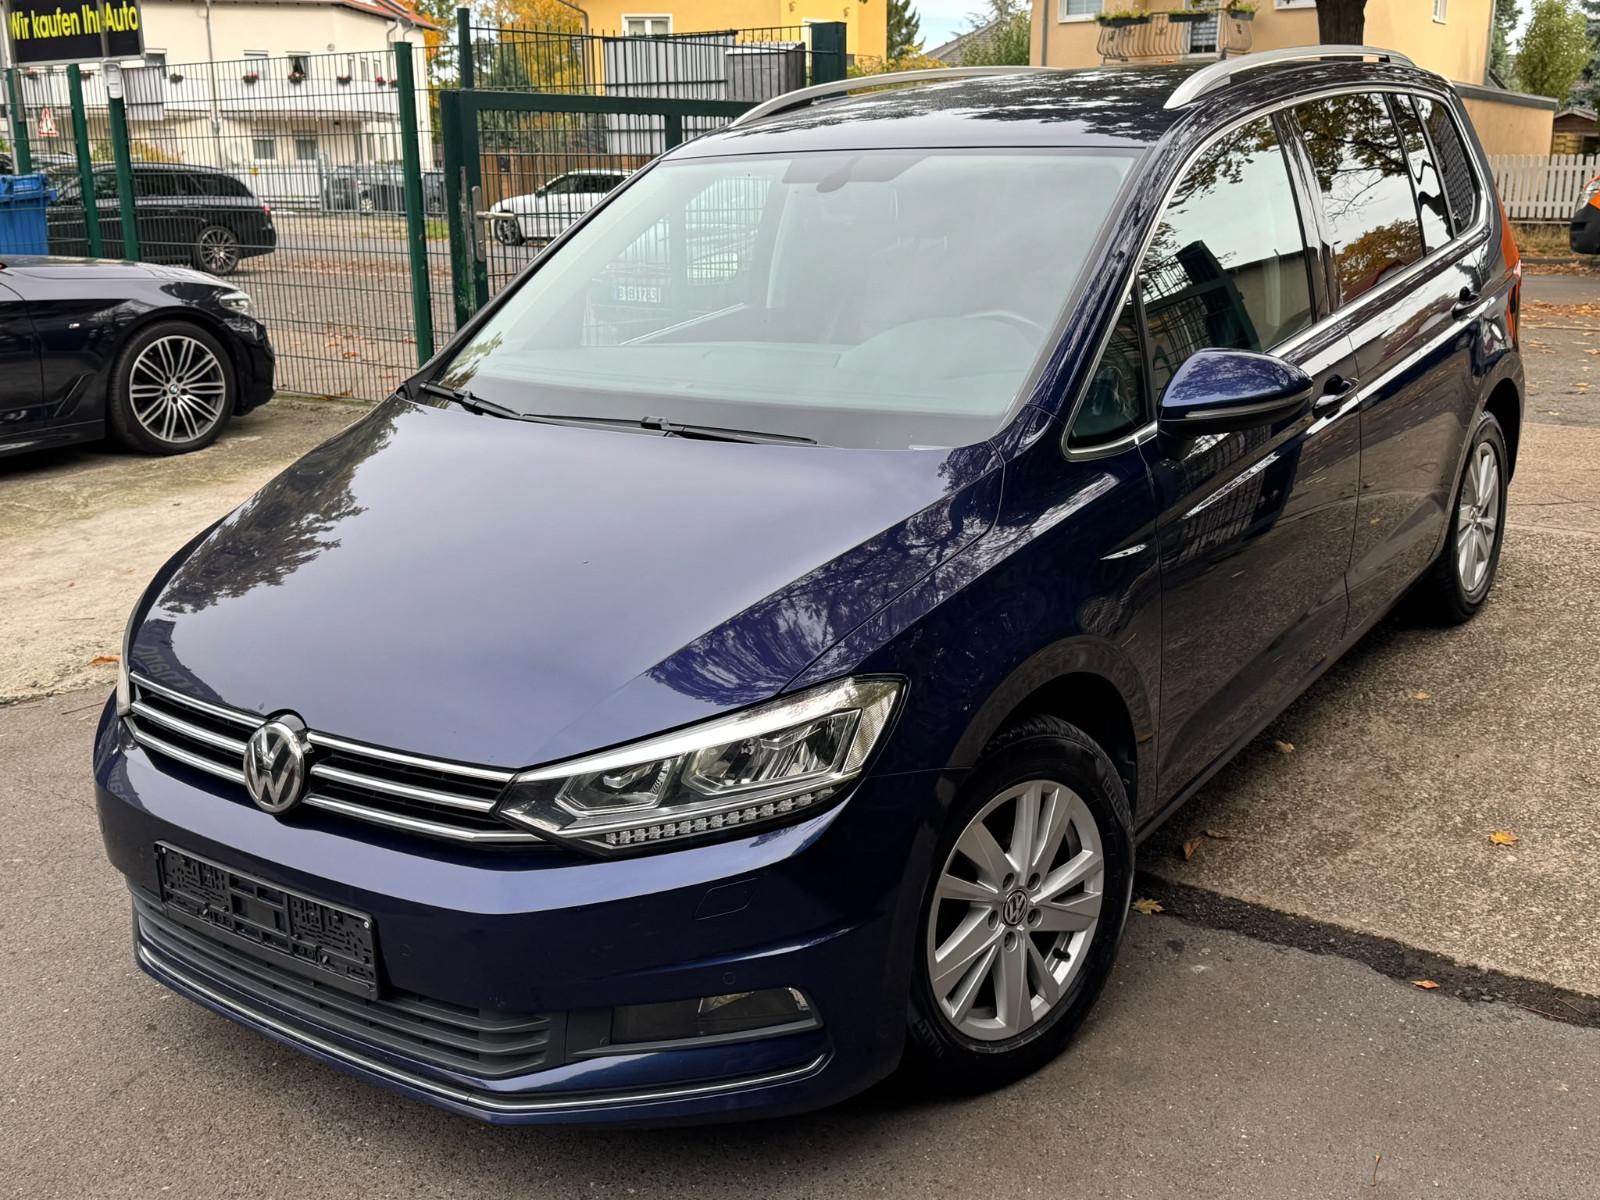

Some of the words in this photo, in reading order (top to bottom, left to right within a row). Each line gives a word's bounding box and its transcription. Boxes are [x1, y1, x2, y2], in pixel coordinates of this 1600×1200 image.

[9, 11, 30, 40] Wir
[31, 7, 80, 39] kaufen
[105, 1, 139, 32] Auto
[243, 721, 304, 812] VW
[1004, 890, 1027, 926] VW
